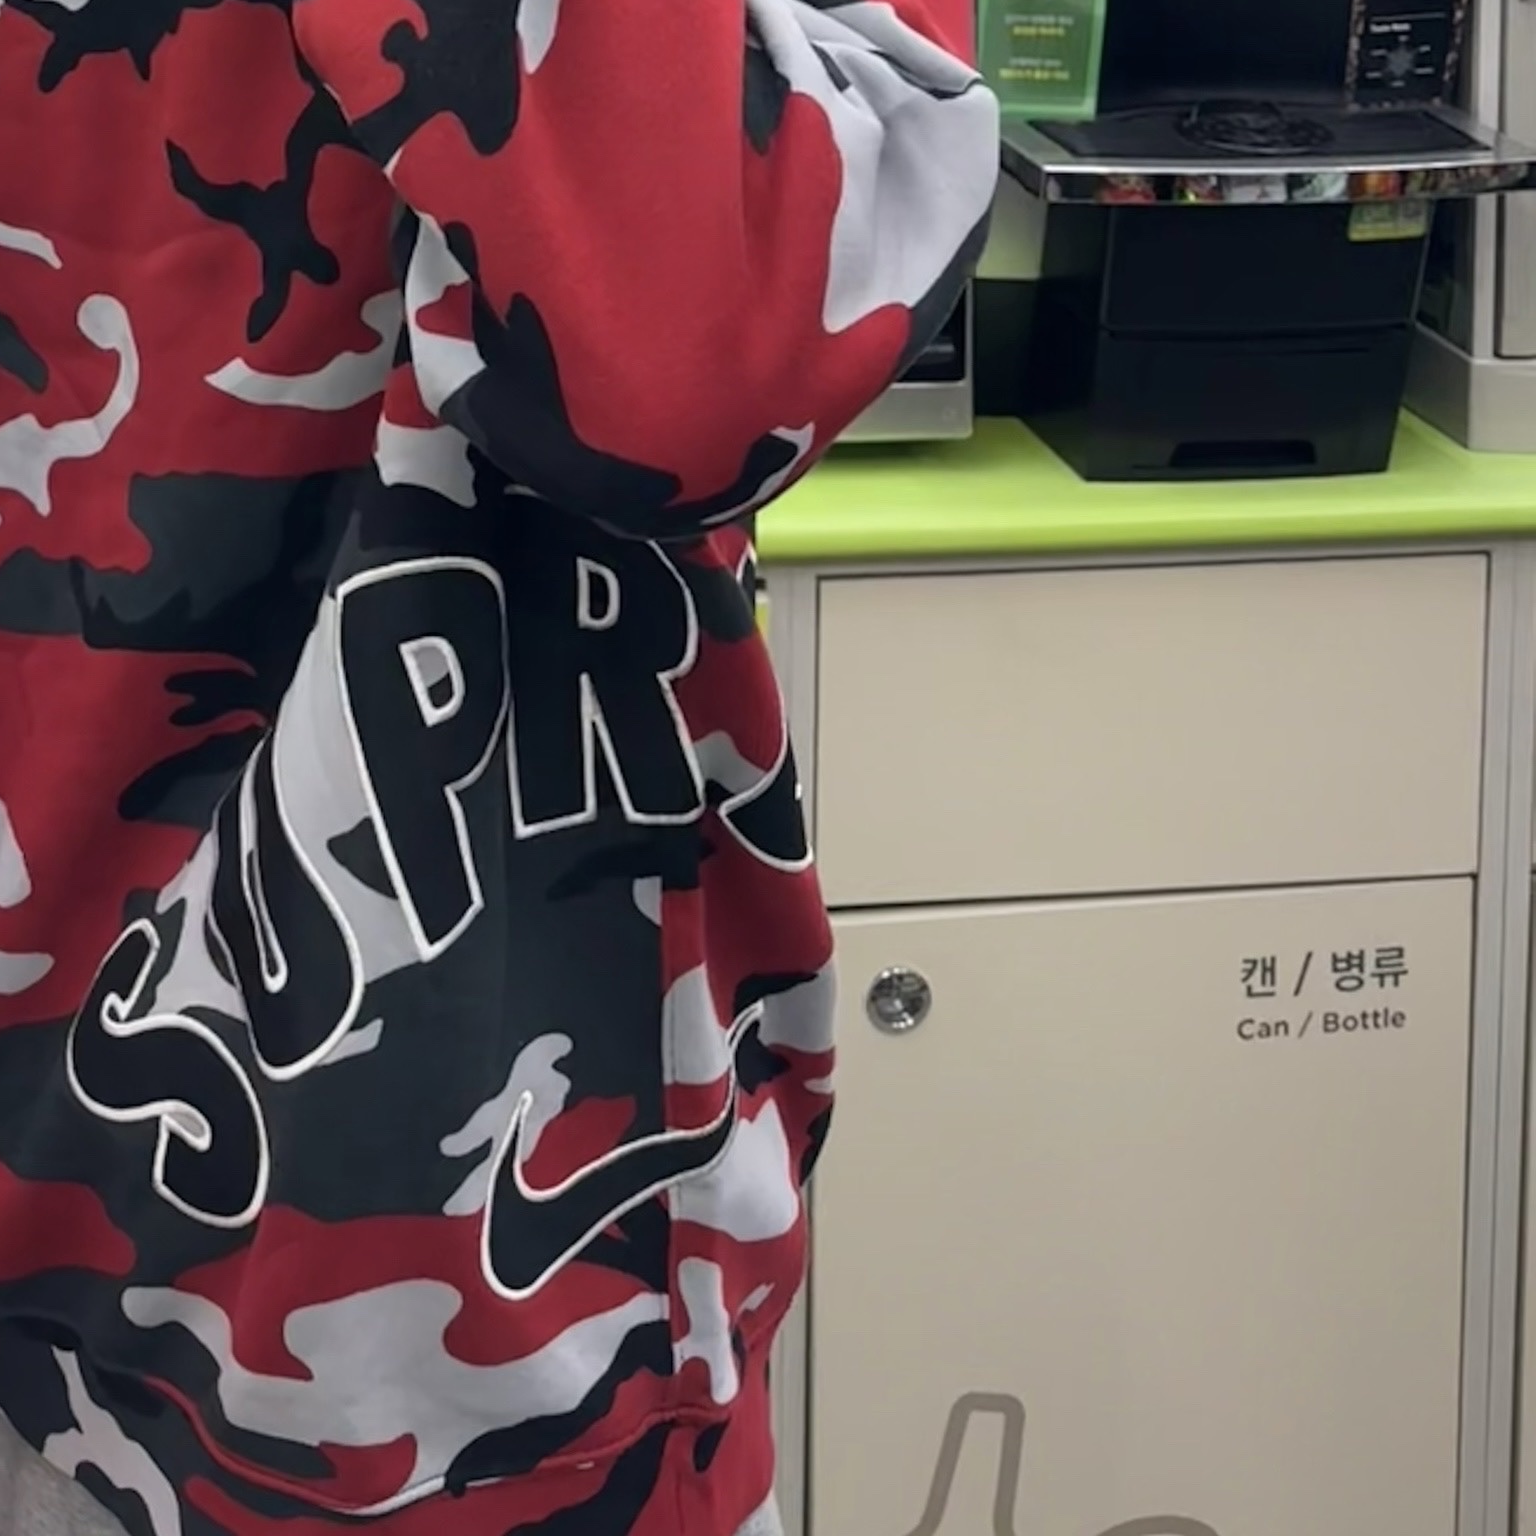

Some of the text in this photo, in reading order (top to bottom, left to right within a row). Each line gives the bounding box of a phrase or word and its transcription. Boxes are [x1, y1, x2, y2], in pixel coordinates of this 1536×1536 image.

[1240, 945, 1409, 997] 캔 / 병류
[1237, 1007, 1407, 1041] Can / Bottle
